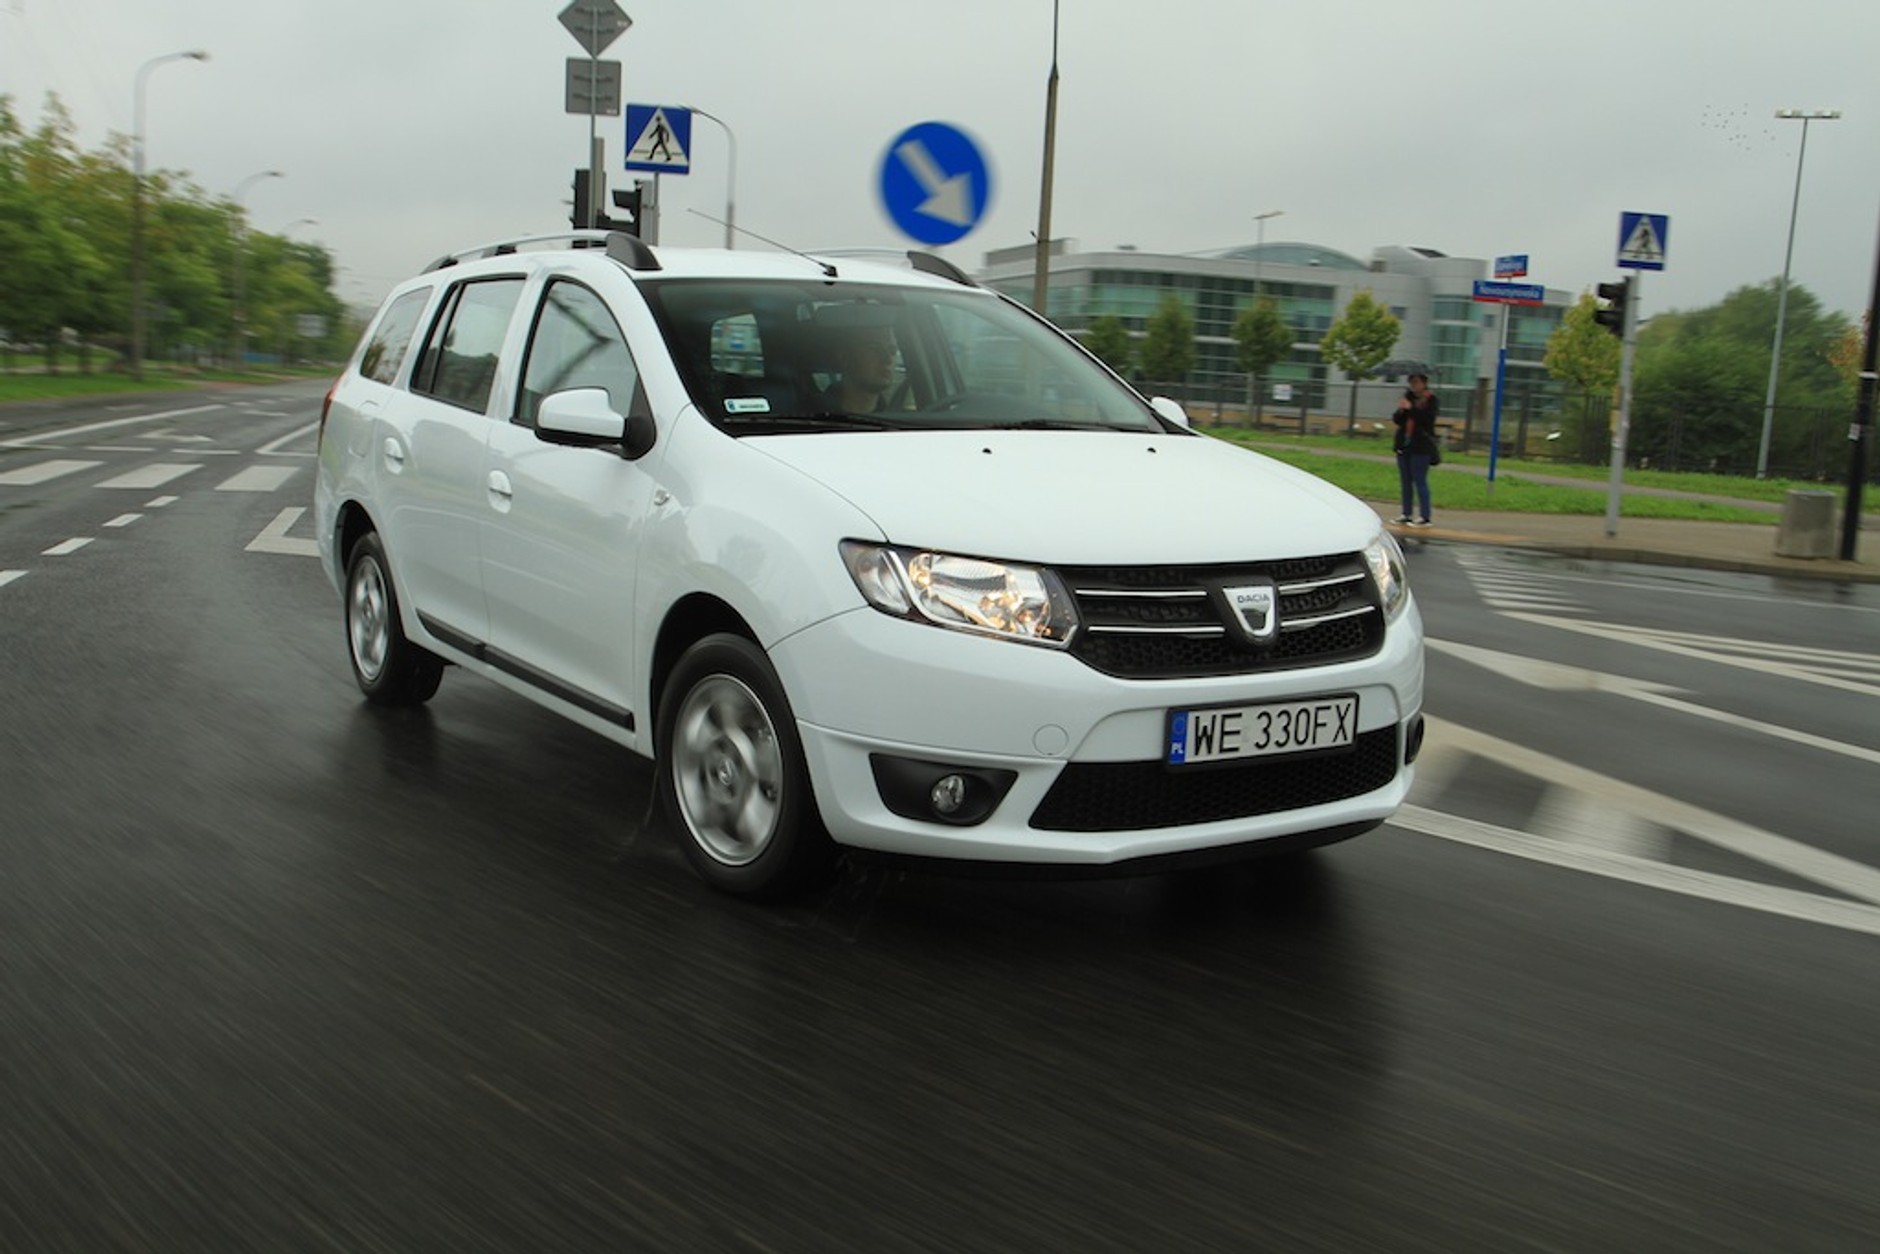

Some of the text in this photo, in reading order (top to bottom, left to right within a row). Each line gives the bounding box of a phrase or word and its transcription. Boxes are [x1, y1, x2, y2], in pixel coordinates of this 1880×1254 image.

[1237, 593, 1270, 604] DACIA
[1194, 703, 1351, 756] WE 330FX
[1171, 742, 1184, 755] PL
